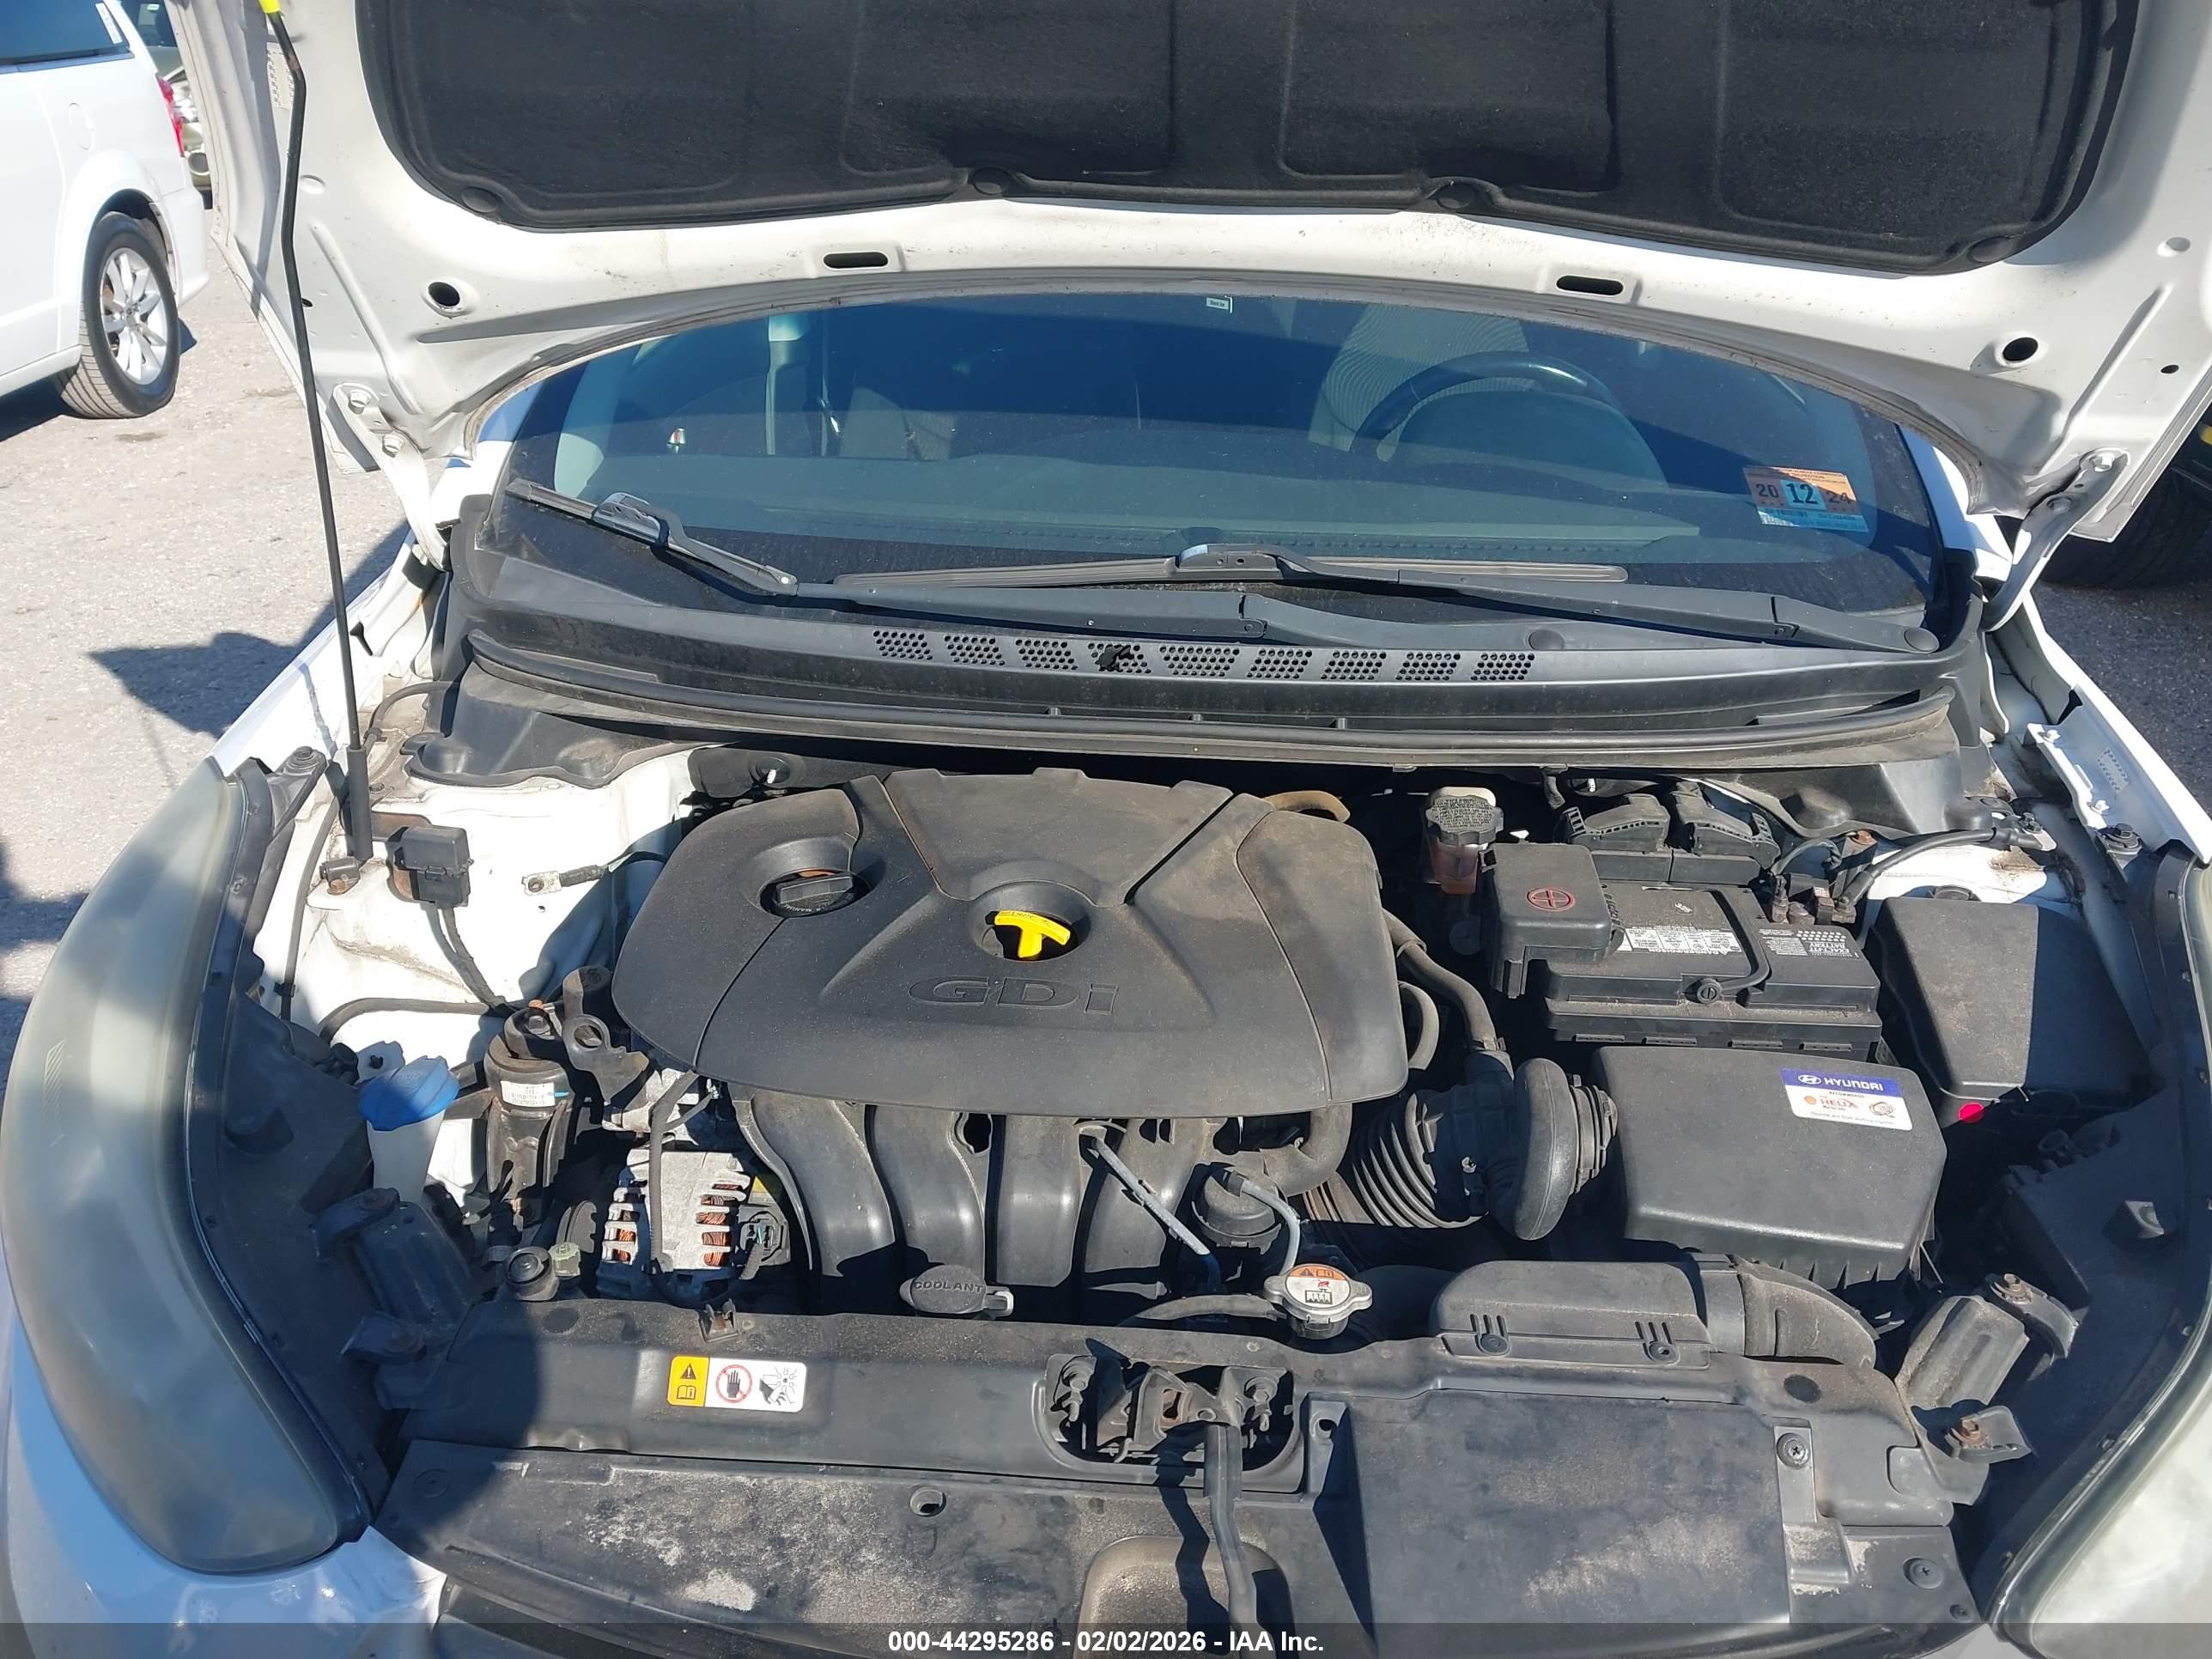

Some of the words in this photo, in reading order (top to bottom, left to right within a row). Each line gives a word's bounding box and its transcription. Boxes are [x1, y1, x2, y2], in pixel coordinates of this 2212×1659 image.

[1756, 483, 1779, 498] 20
[1786, 483, 1819, 505] 12
[1825, 1077, 1884, 1091] HYUNDAI
[913, 1280, 984, 1293] COOLANT
